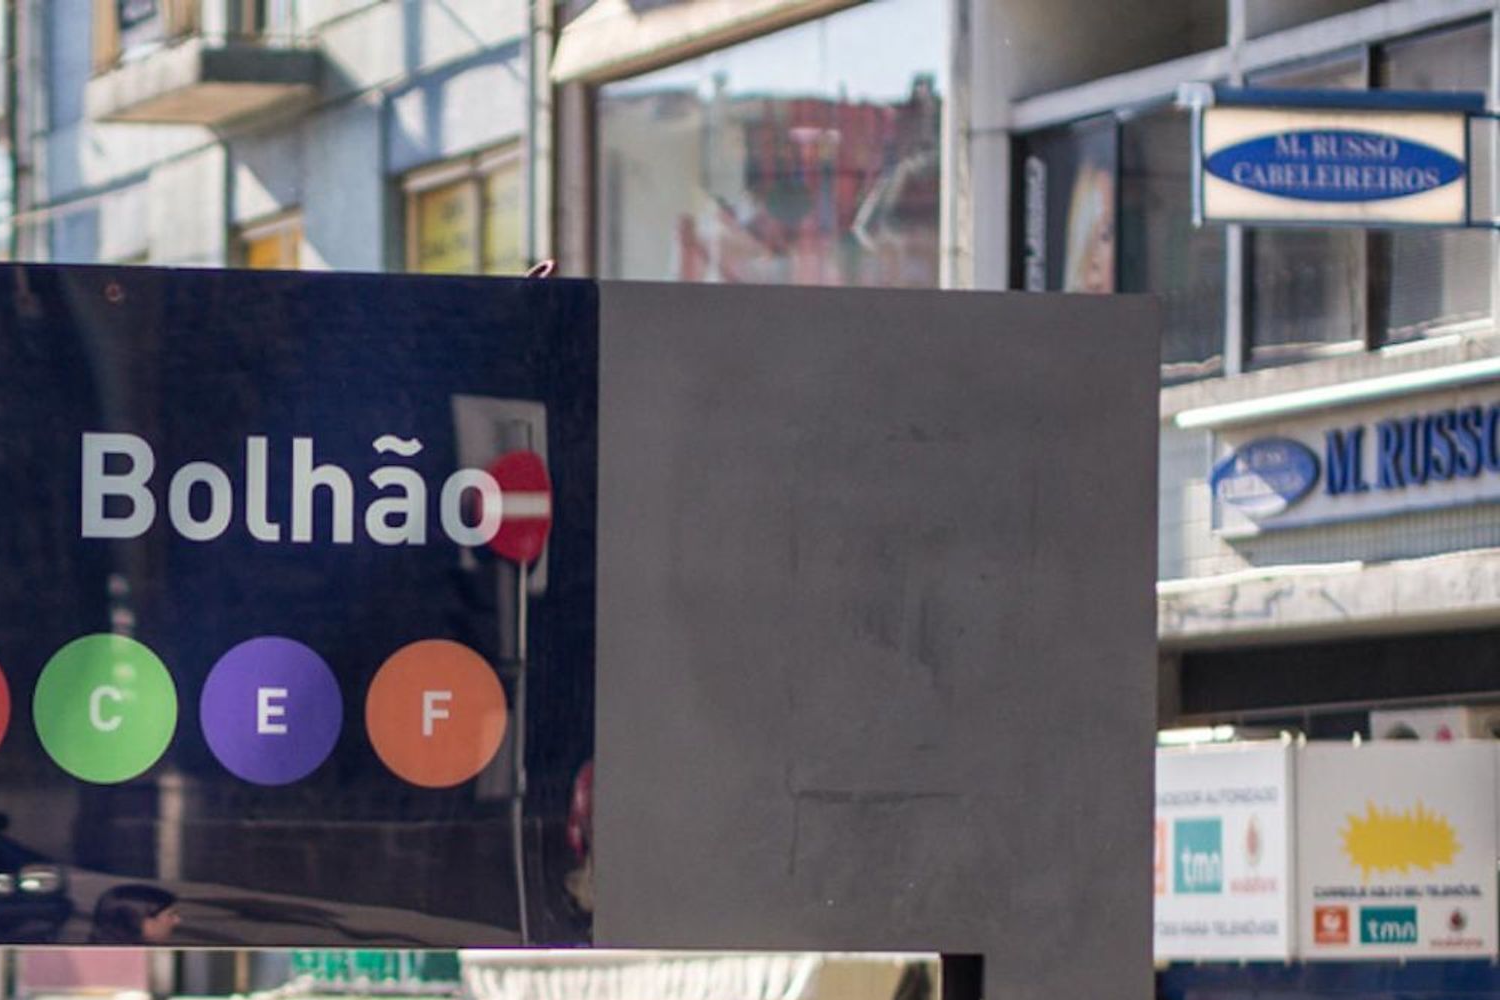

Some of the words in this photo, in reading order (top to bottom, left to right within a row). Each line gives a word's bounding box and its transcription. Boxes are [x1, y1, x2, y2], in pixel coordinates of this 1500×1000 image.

[1274, 134, 1305, 158] M.
[1311, 135, 1399, 160] RUSSO
[1232, 162, 1440, 190] CABELEIREIROS
[1324, 426, 1369, 494] M.
[81, 432, 503, 547] Bolhão
[88, 686, 123, 733] C
[257, 688, 288, 735] E
[422, 690, 452, 737] F
[1181, 846, 1221, 887] tmn
[1367, 918, 1416, 941] tmn
